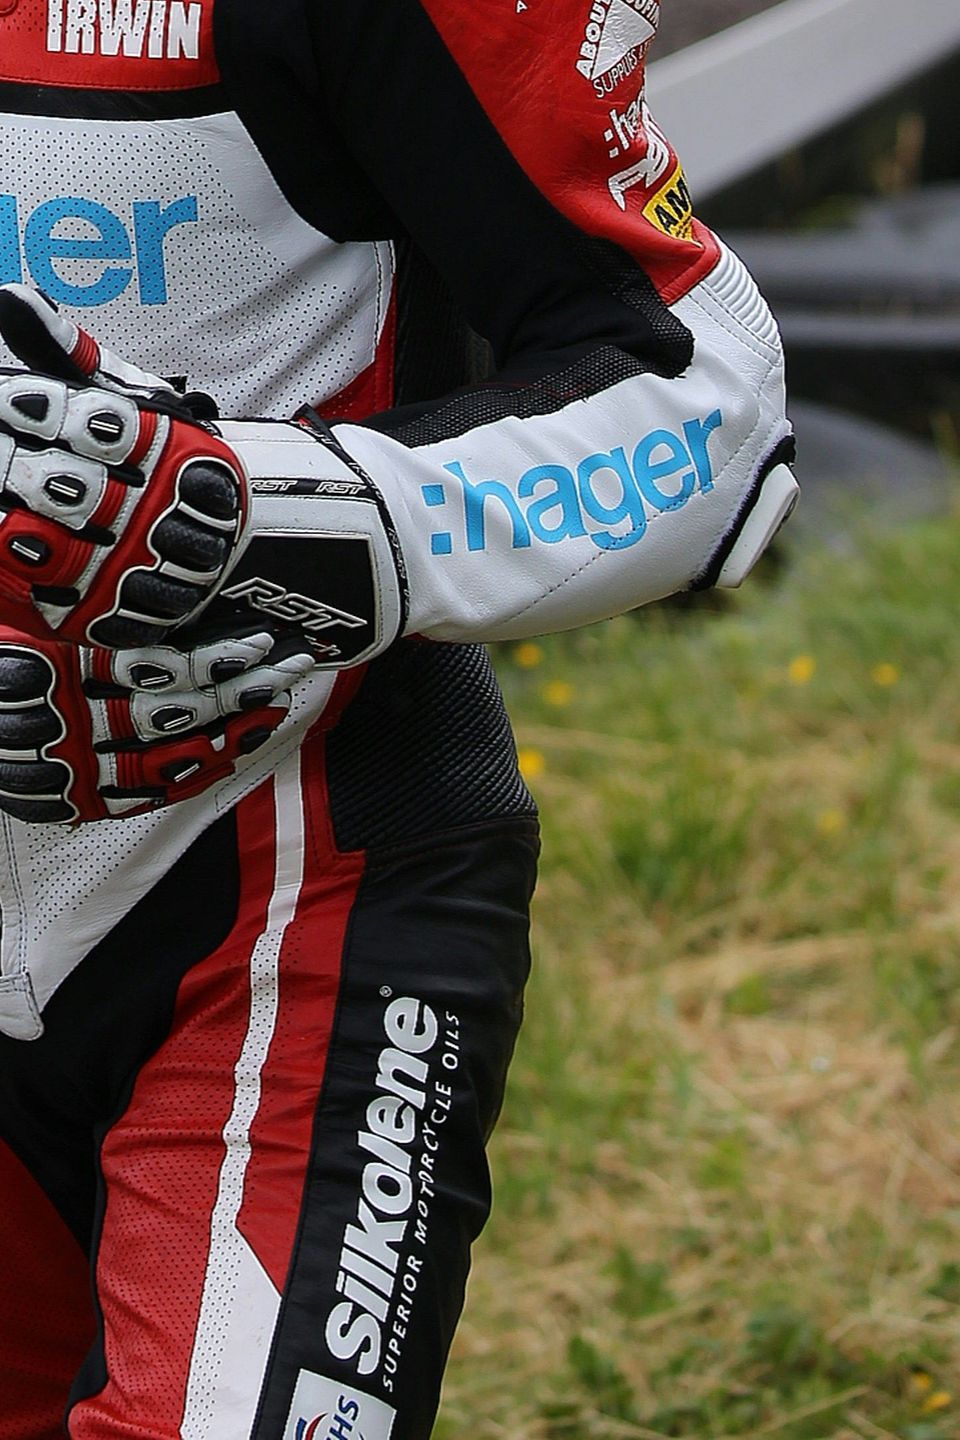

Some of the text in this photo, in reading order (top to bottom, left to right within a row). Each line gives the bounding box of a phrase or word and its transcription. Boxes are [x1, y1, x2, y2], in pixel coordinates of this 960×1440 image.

[593, 49, 637, 98] SUPPLIES
[251, 479, 298, 493] RST
[315, 480, 368, 495] RST
[220, 576, 368, 631] RST
[383, 1012, 460, 1392] SUPERIOR MOTORCYCLE OILS
